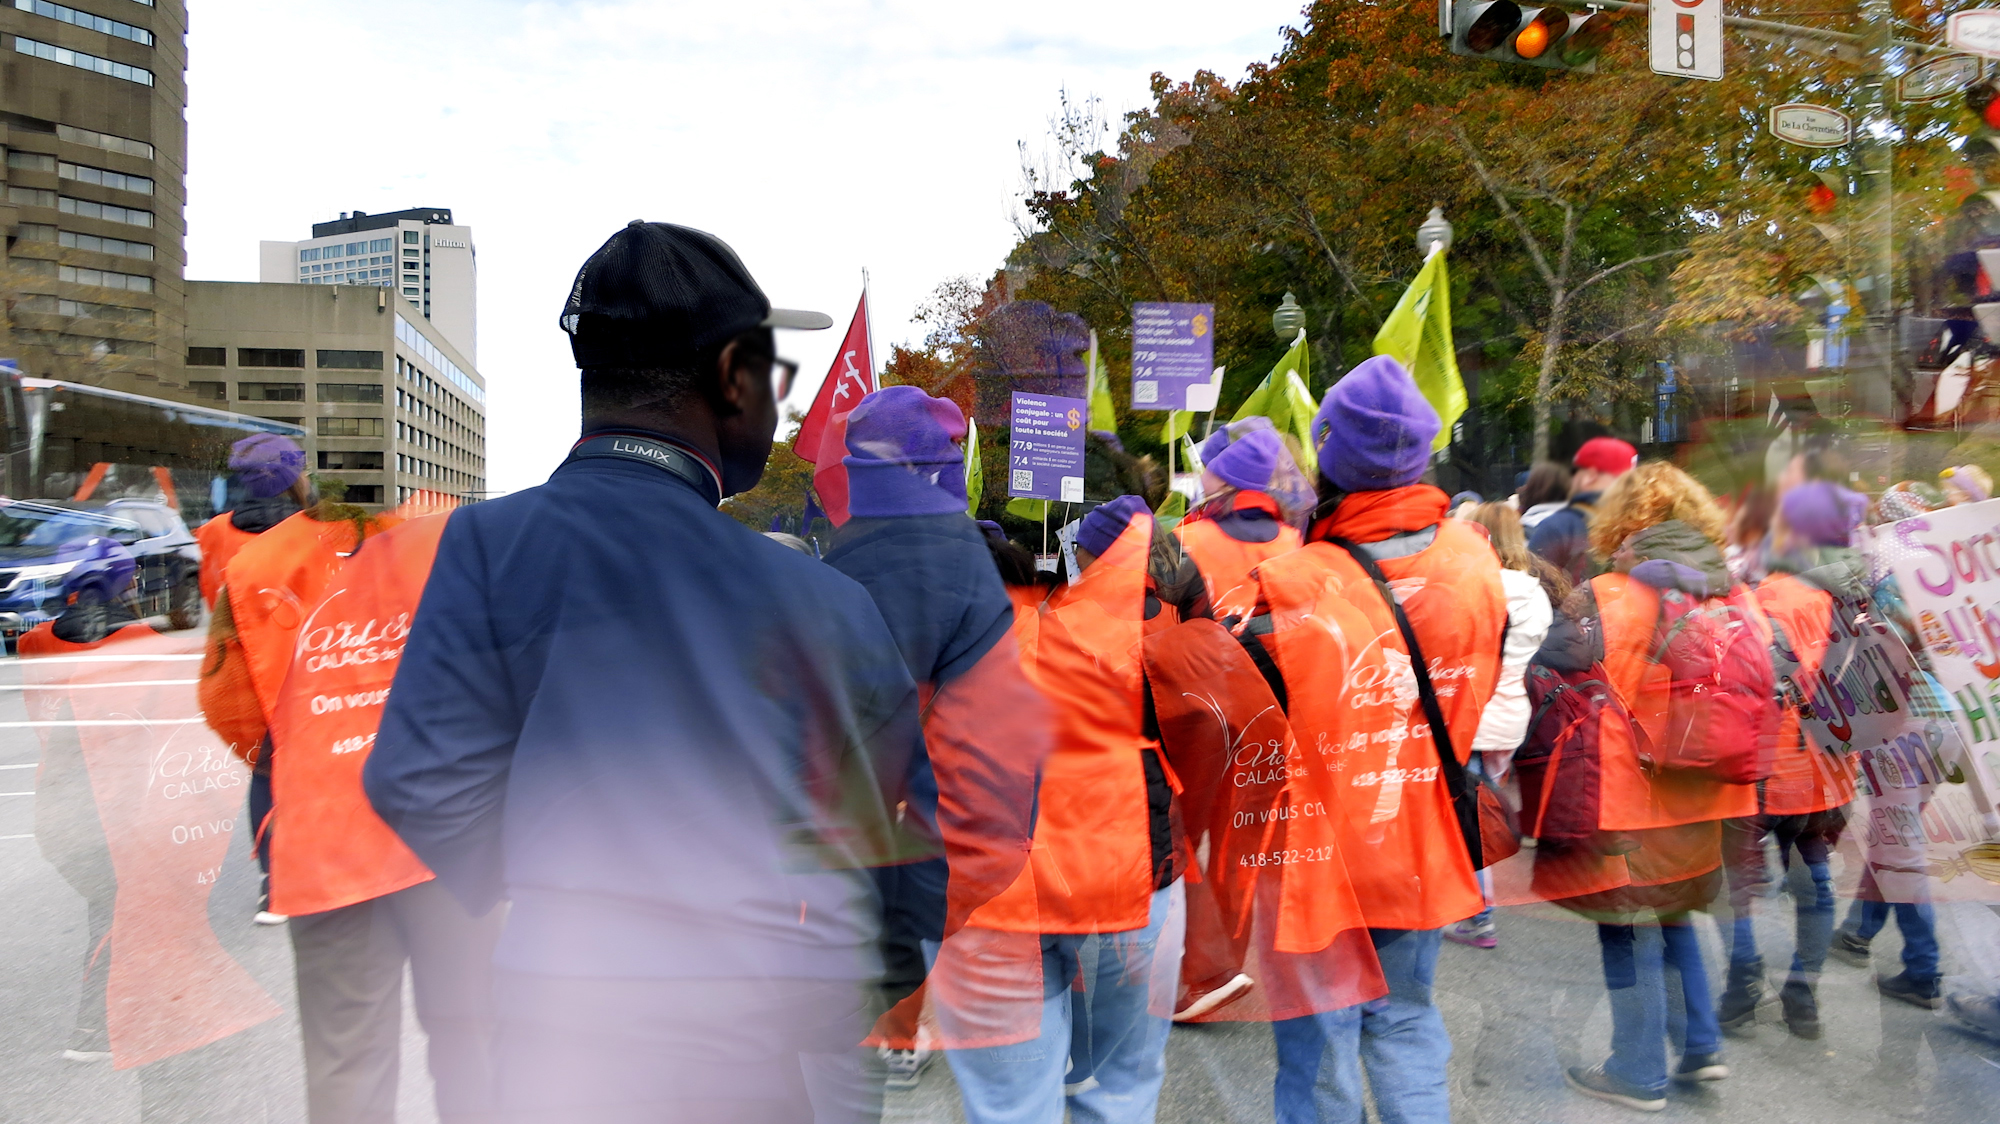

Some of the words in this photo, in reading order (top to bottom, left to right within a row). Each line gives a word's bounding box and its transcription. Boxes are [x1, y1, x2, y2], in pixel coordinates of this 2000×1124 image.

[1781, 120, 1791, 128] De
[1792, 121, 1800, 130] La
[434, 238, 466, 248] Hilton
[1016, 397, 1047, 407] Violence
[1015, 407, 1050, 417] conjugale
[1015, 416, 1032, 425] coût
[1015, 426, 1034, 434] toute
[1034, 427, 1042, 435] la
[1042, 429, 1068, 438] société
[612, 439, 670, 464] LUMIX
[1012, 440, 1033, 452] 77,9
[1013, 455, 1029, 466] 7,4
[305, 645, 379, 673] CALACS
[310, 694, 344, 716] On
[1233, 764, 1293, 788] CALACS
[163, 770, 242, 800] CALACS
[1233, 810, 1255, 829] On
[1260, 804, 1299, 824] vous
[171, 824, 204, 845] On
